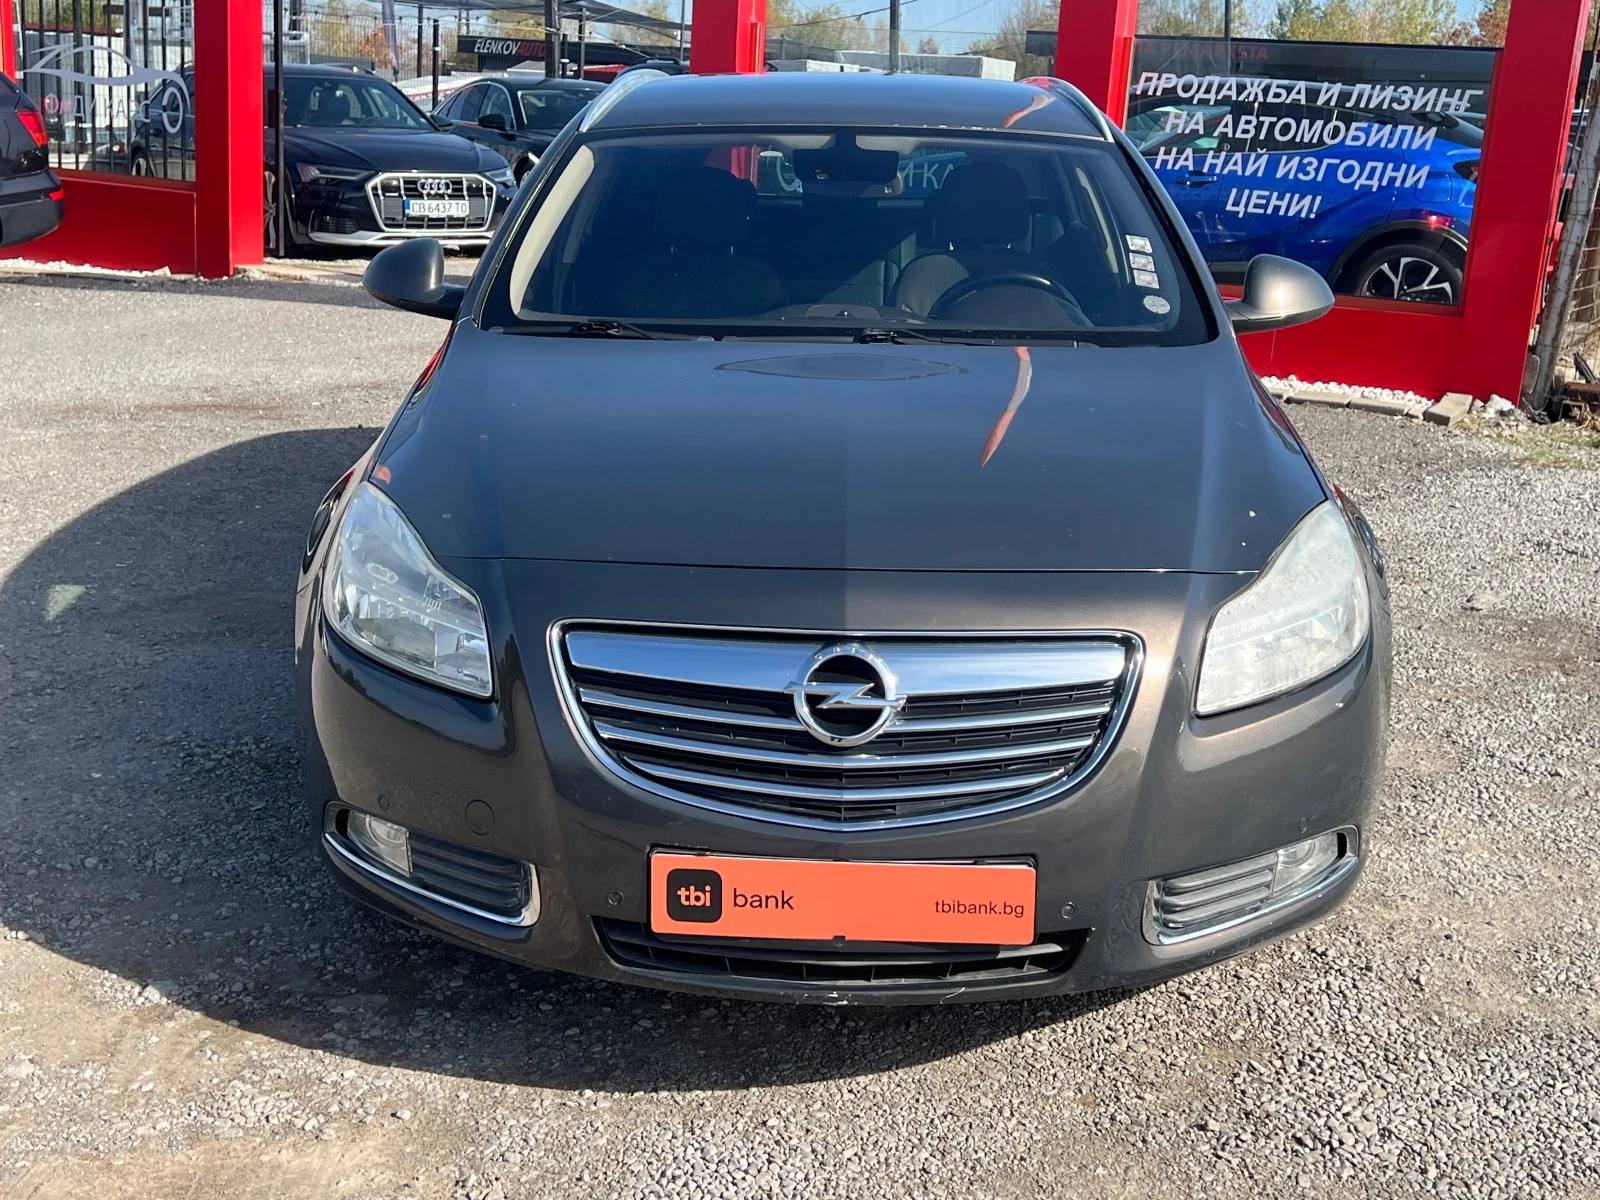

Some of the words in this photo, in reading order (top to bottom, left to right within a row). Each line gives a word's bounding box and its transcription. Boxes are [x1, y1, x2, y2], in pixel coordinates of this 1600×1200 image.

[1136, 72, 1307, 106] ПРОДАЖБА
[1317, 81, 1342, 107] И
[1345, 83, 1484, 113] ЛИЗИНГ
[1165, 111, 1205, 135] НА
[1213, 114, 1438, 151] АВТОМОБИЛИ
[1154, 146, 1195, 171] НА
[1202, 148, 1268, 178] НАЙ
[1275, 155, 1431, 190] ИЗГОДНИ
[411, 202, 426, 214] CB
[428, 202, 453, 214] 6437
[1225, 188, 1323, 219] ЦЕНИ!
[676, 885, 712, 907] tbi
[733, 888, 795, 911] bank
[934, 900, 1025, 919] tbibank.bg
